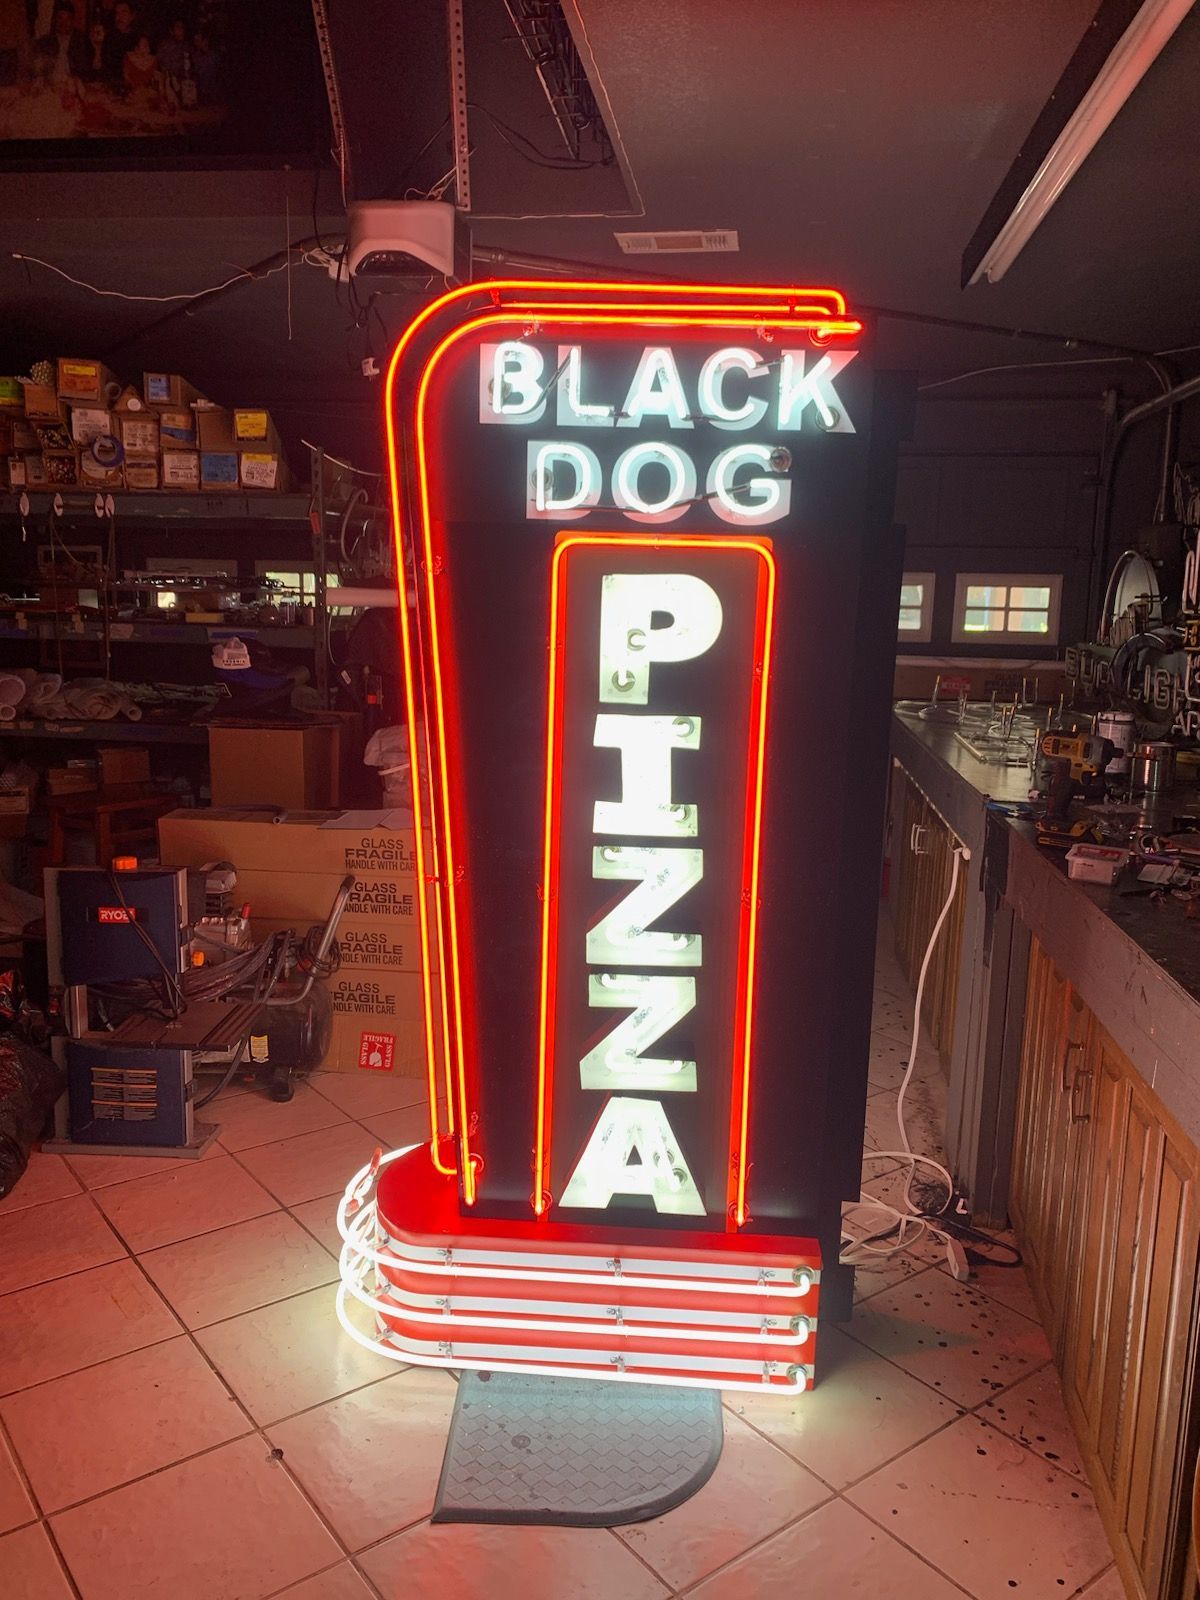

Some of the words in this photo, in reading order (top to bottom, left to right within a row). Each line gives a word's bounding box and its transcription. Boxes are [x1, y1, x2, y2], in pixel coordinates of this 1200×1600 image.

[479, 341, 859, 434] BLACK
[526, 440, 792, 526] DOG
[361, 838, 404, 850] GLASS
[345, 848, 416, 861] FRAGILE
[345, 860, 376, 870] HANDLE
[377, 861, 398, 871] WITH
[400, 861, 416, 872] CAR
[354, 882, 397, 893] GLASS
[349, 893, 413, 905] RAGILE
[559, 573, 724, 1216] PIZZA
[343, 903, 369, 914] ANDLE
[370, 904, 391, 915] WITH
[392, 905, 414, 916] CARE
[345, 931, 387, 943] GLASS
[339, 942, 403, 955] RAGILE
[340, 953, 358, 963] NDLE
[360, 954, 381, 965] WITH
[383, 955, 403, 966] CARE
[338, 981, 380, 993] GLASS
[331, 991, 396, 1005] RAGILE
[333, 1002, 353, 1013] NDLE
[355, 1003, 374, 1014] WITH
[376, 1005, 396, 1015] CARE
[363, 1034, 393, 1044] FRAGILE
[360, 1042, 369, 1065] GLASS
[384, 1044, 393, 1067] GLASS
